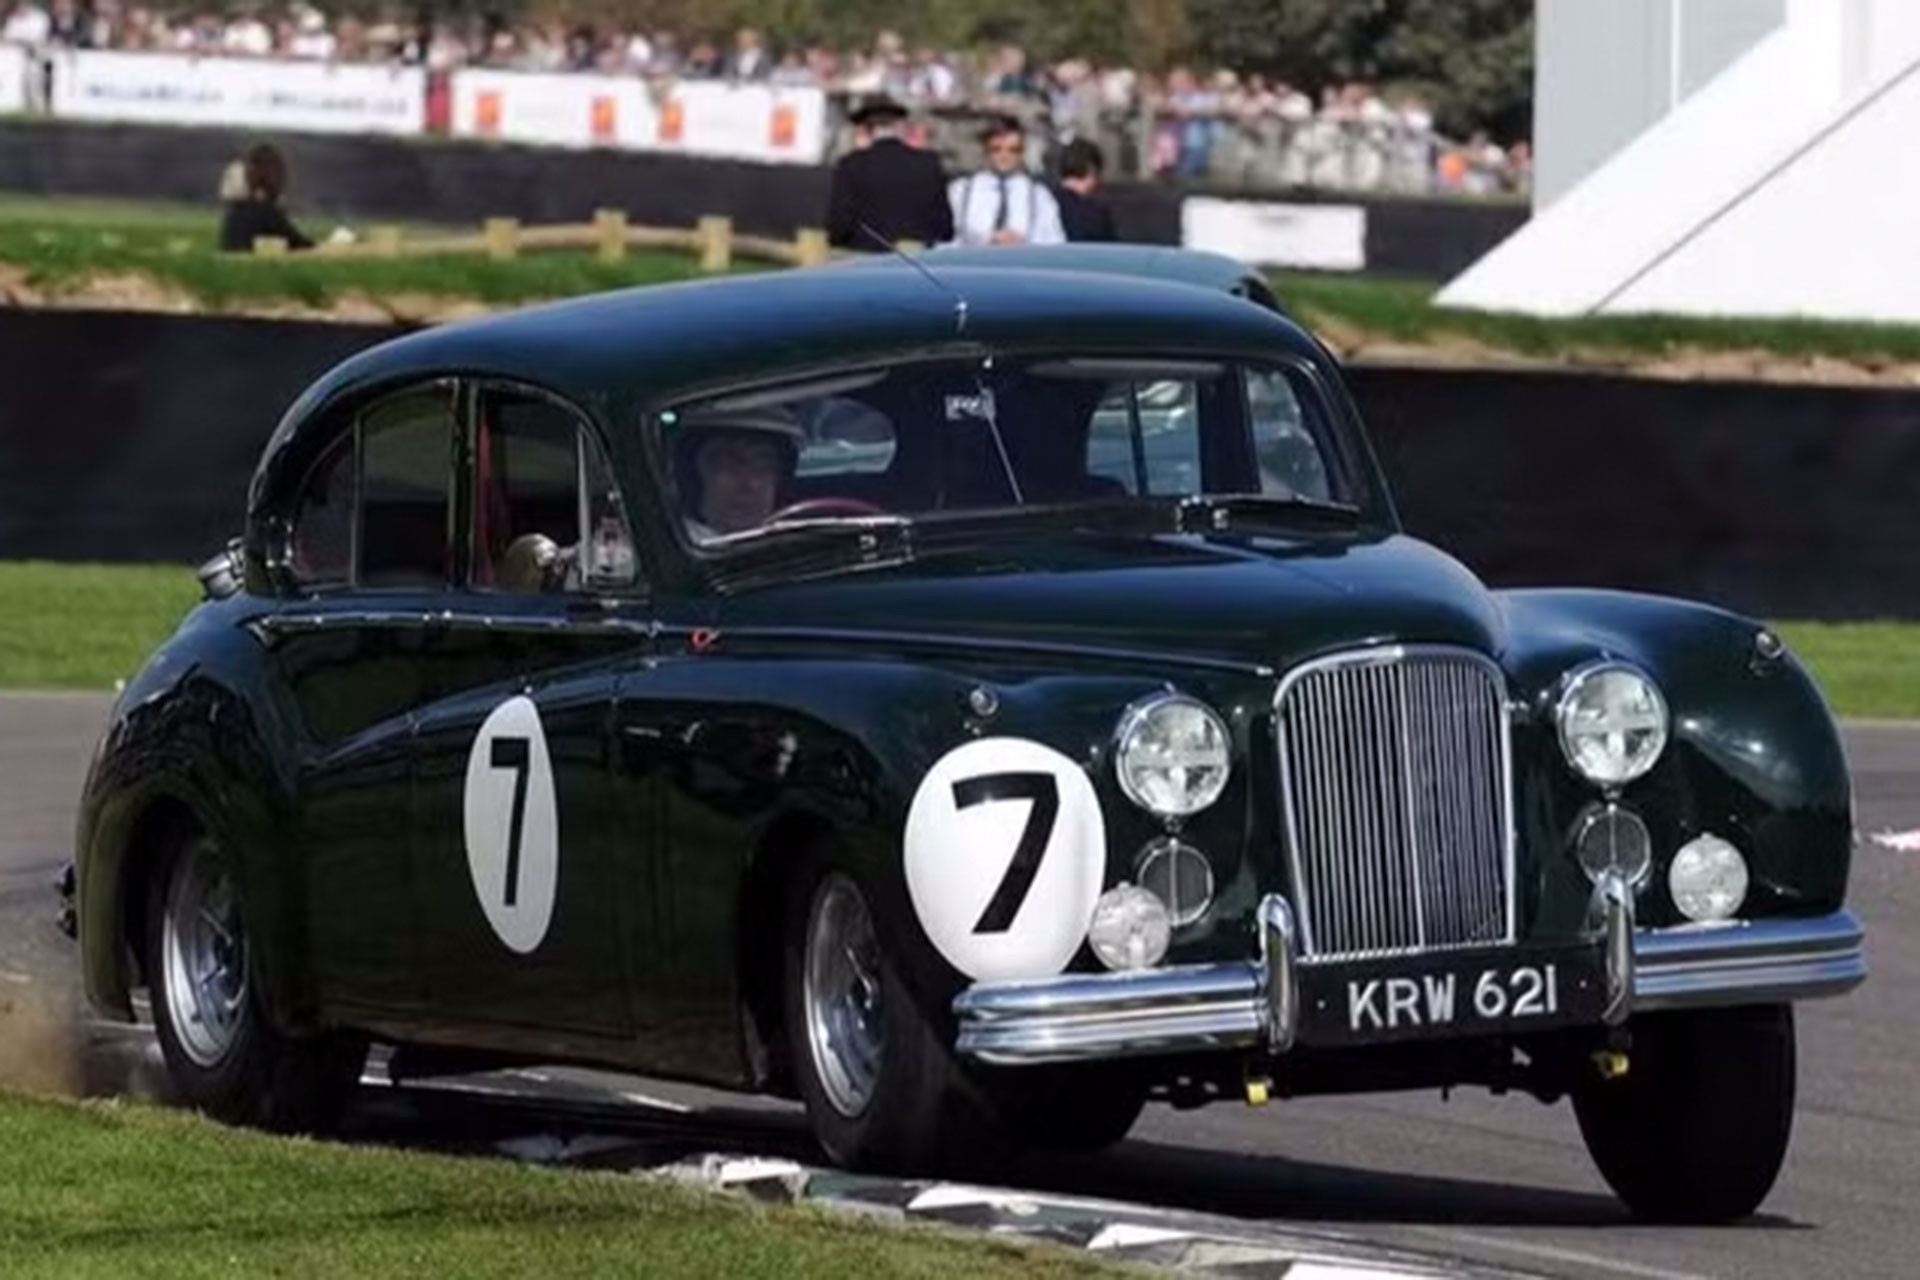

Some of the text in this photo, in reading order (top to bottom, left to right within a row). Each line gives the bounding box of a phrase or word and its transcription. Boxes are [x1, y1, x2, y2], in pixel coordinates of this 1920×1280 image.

[490, 737, 530, 906] 7
[952, 772, 1060, 934] 7
[1349, 964, 1557, 1029] KRW 621
